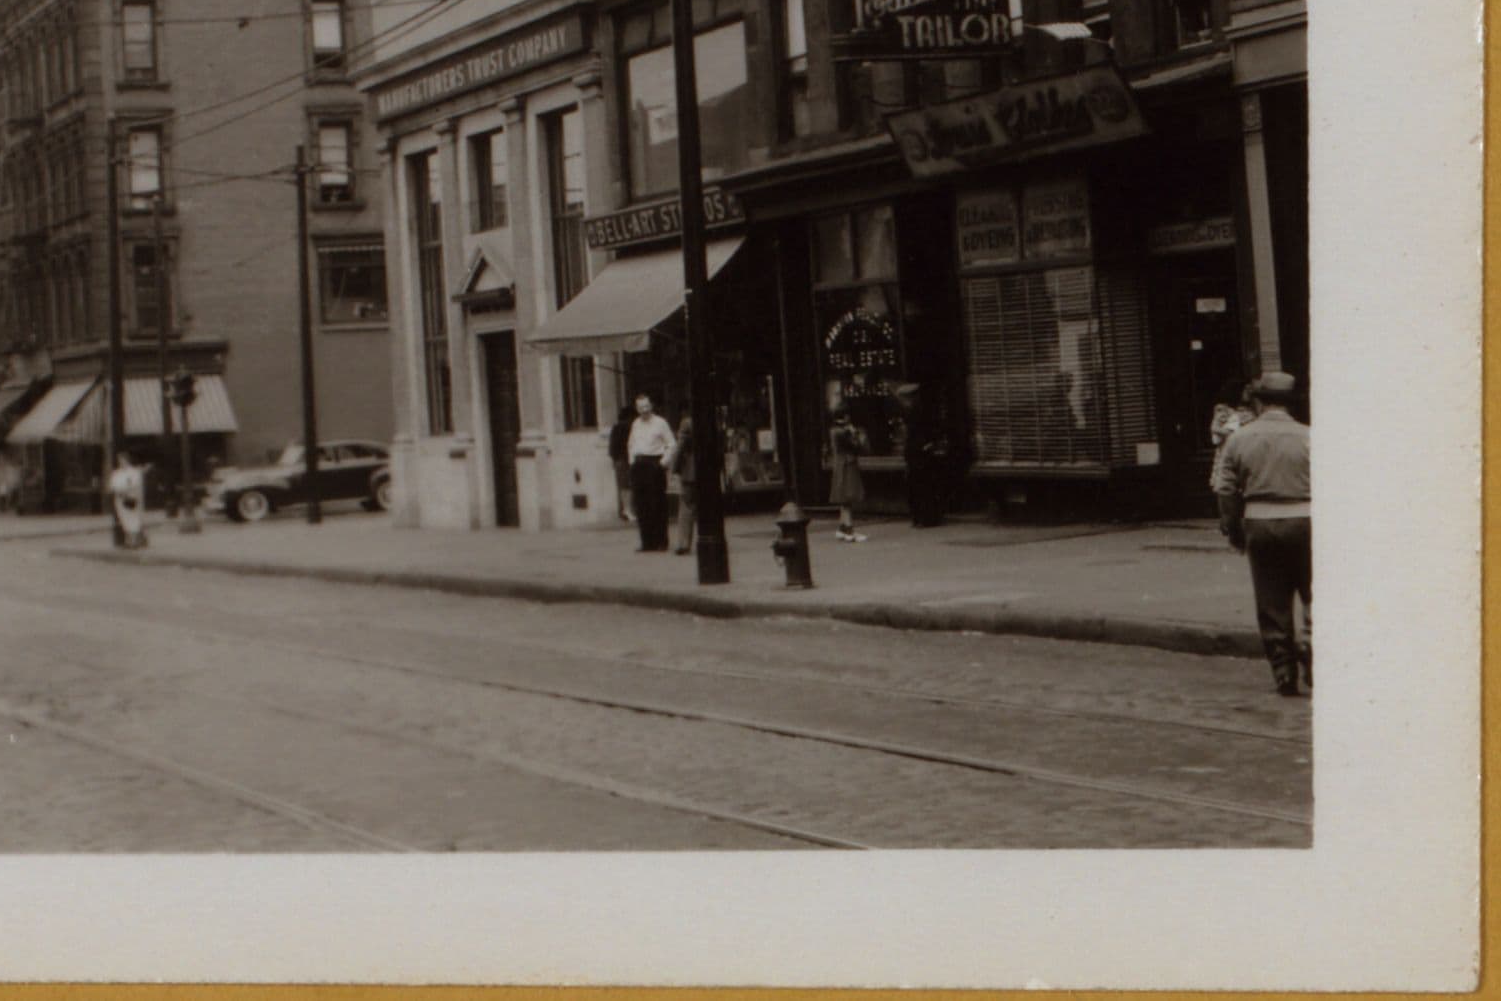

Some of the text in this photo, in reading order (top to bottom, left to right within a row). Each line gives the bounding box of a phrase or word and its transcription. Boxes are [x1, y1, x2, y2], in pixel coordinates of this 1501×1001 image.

[896, 12, 1012, 49] TAILOR
[377, 25, 567, 116] MANUFACTURERS TRUST COMPANY
[660, 192, 726, 233] STOS
